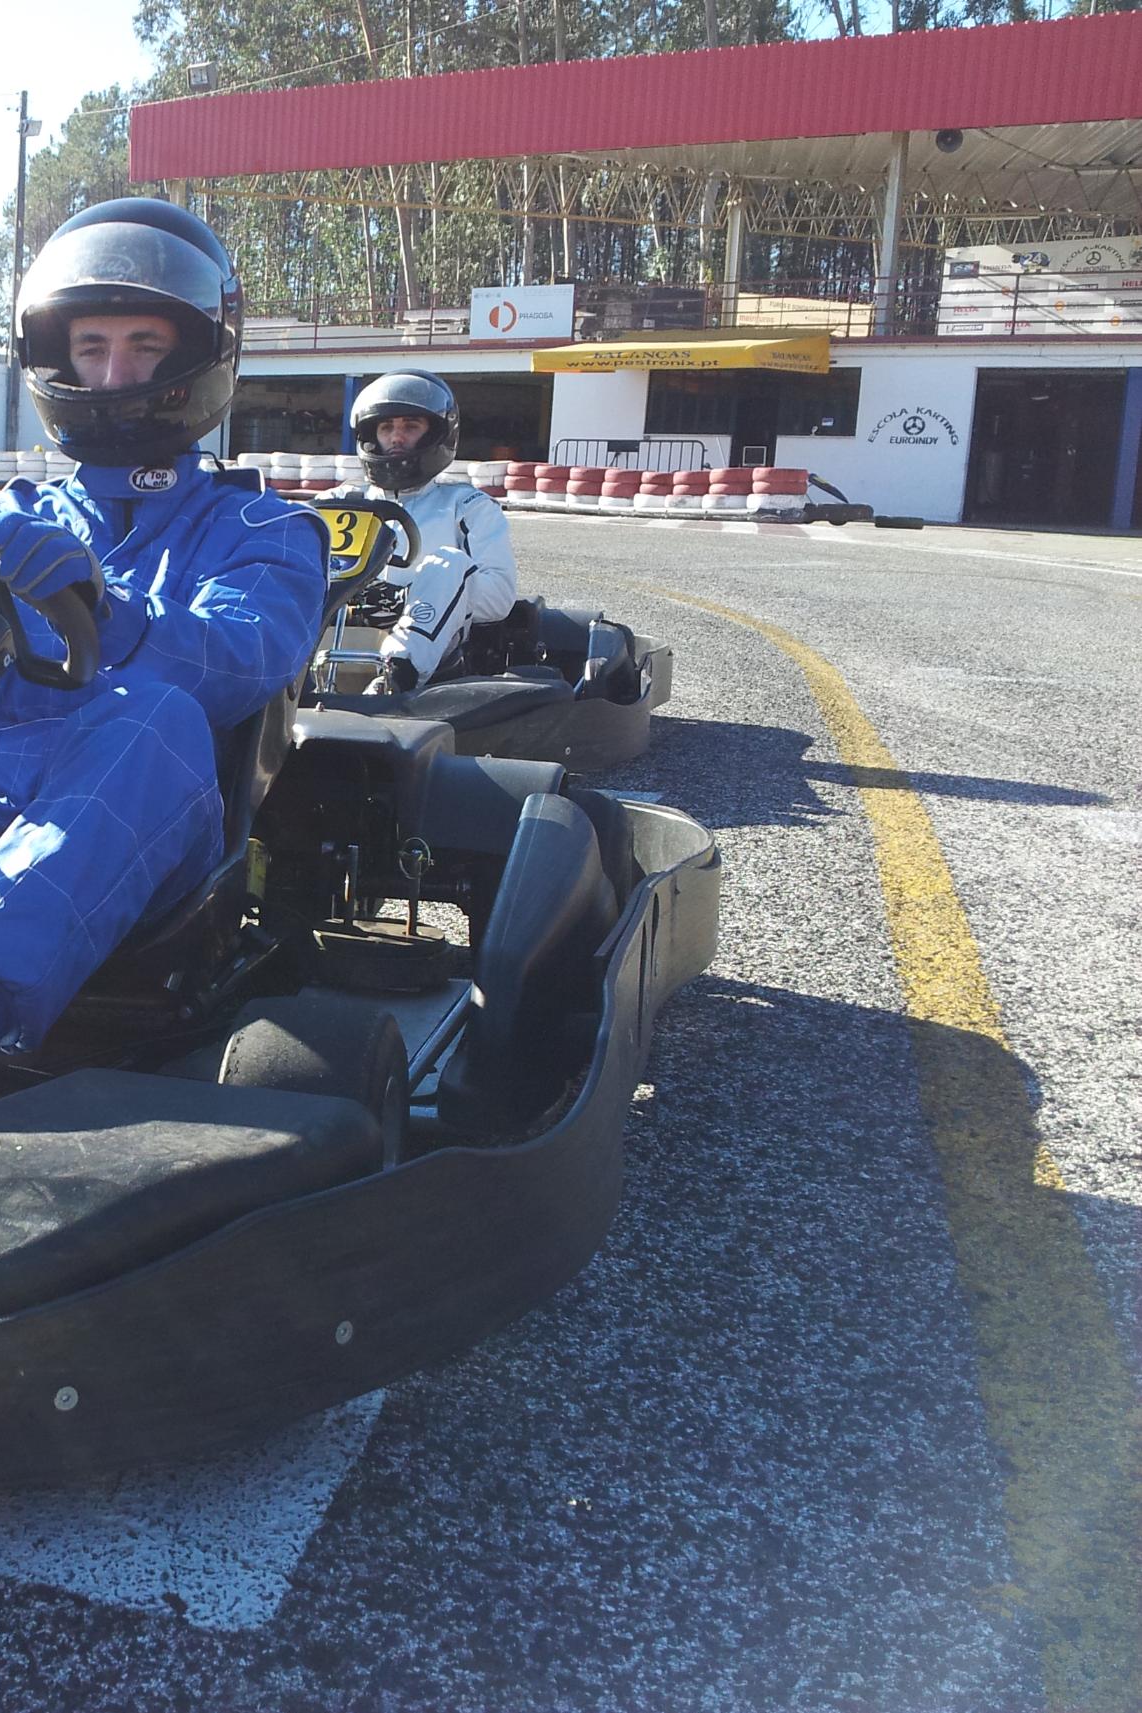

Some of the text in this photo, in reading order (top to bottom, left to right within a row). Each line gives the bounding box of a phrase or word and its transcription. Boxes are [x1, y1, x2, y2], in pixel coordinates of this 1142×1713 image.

[566, 359, 721, 369] www.pestronix.pt
[867, 406, 959, 446] ESCOLA KARTING
[889, 436, 939, 445] EUROINDY
[331, 511, 358, 551] 3
